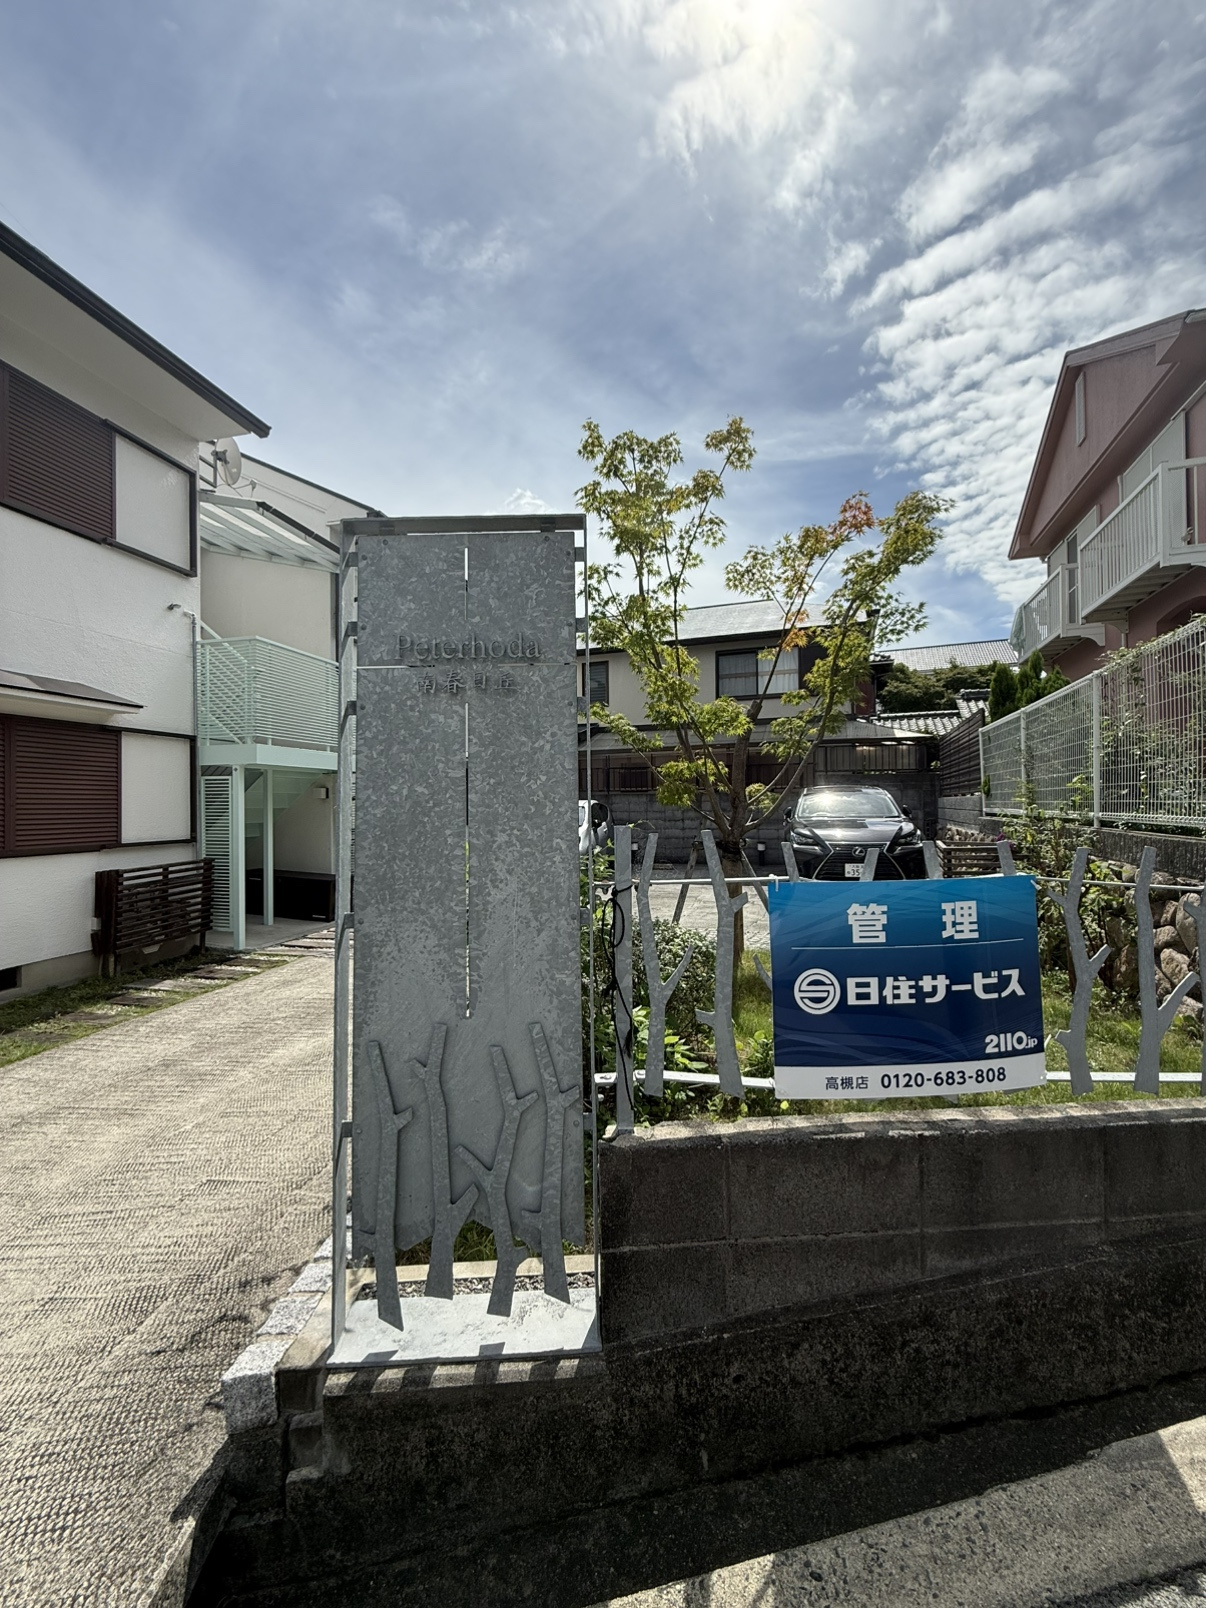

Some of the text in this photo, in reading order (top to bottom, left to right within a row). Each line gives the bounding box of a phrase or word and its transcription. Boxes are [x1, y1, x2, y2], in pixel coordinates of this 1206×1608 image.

[394, 632, 542, 661] Peterhoda
[415, 669, 520, 694] 南春日丘
[846, 968, 1026, 1006] 日住サービス
[824, 1066, 1007, 1091] 高槻店 0120-683-808
